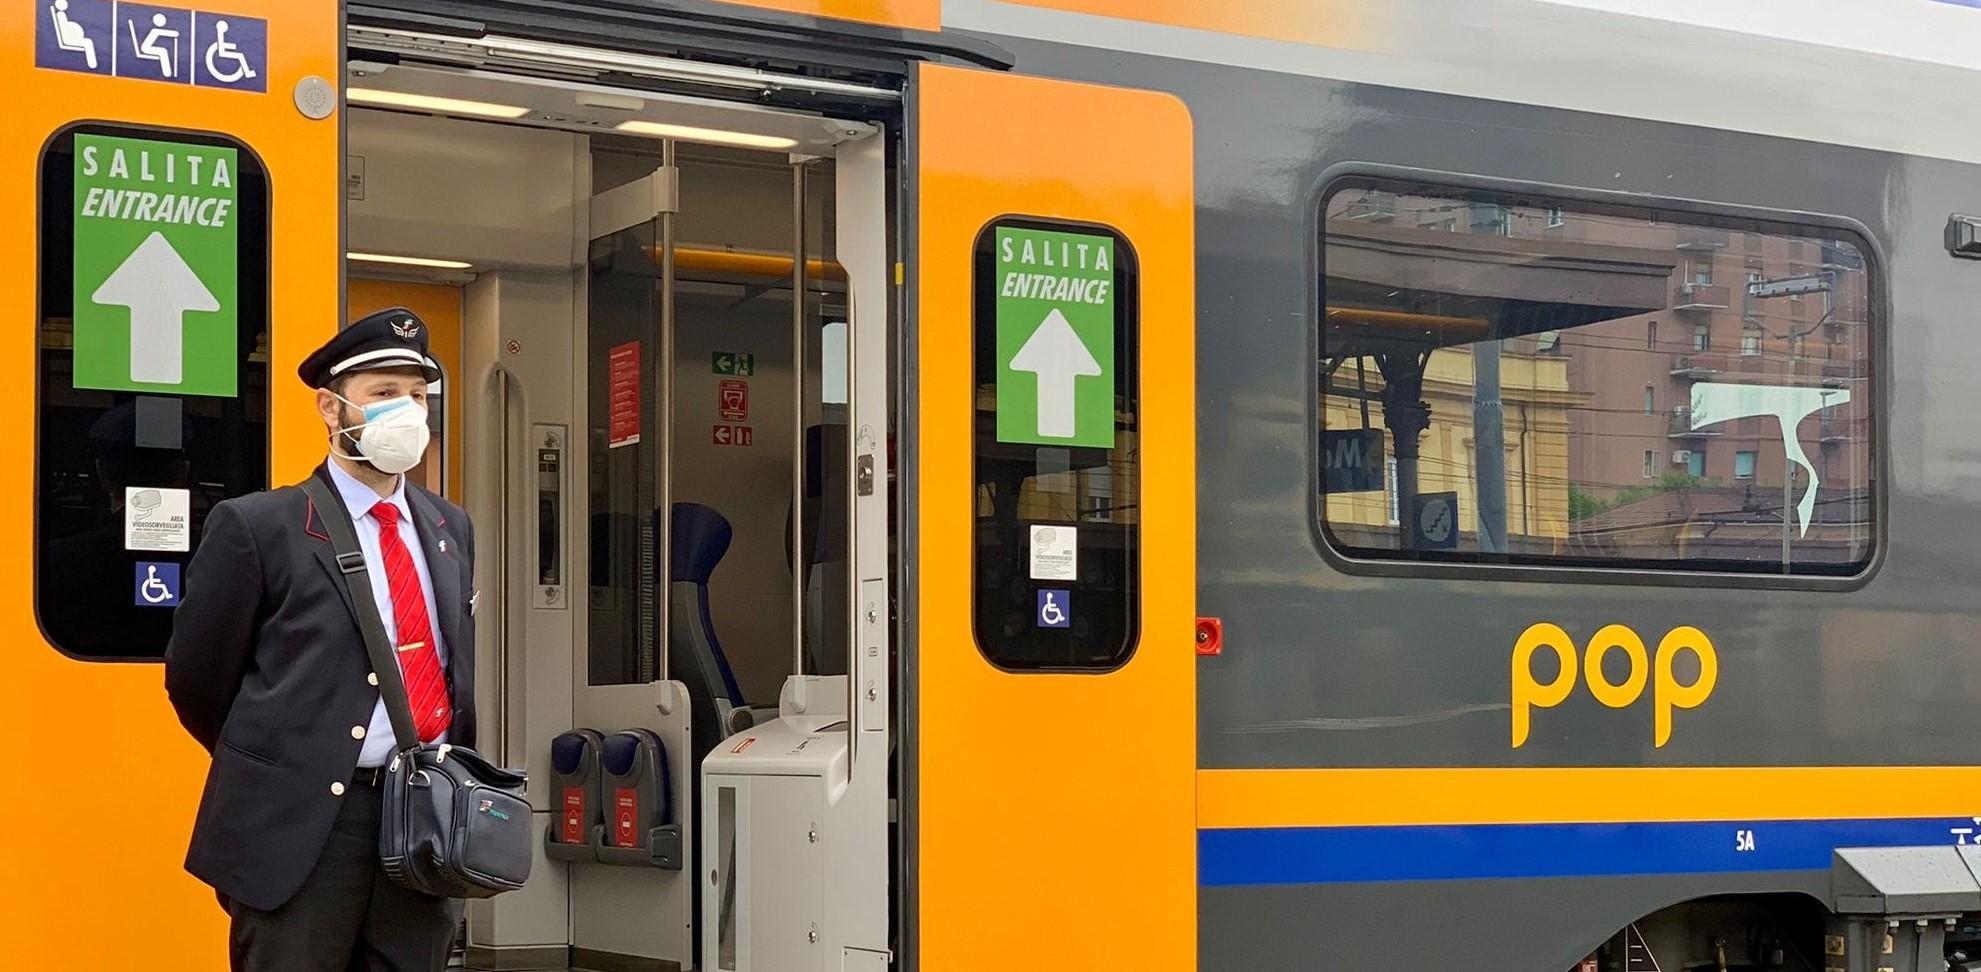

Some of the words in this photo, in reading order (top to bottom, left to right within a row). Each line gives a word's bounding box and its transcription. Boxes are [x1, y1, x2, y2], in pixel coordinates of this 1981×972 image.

[83, 146, 231, 188] SALITA
[81, 187, 232, 227] ENTRANCE
[1002, 236, 1109, 271] SALITA
[1001, 272, 1109, 304] ENTRANCE
[1511, 622, 1718, 749] pop
[1736, 830, 1755, 851] 5A
